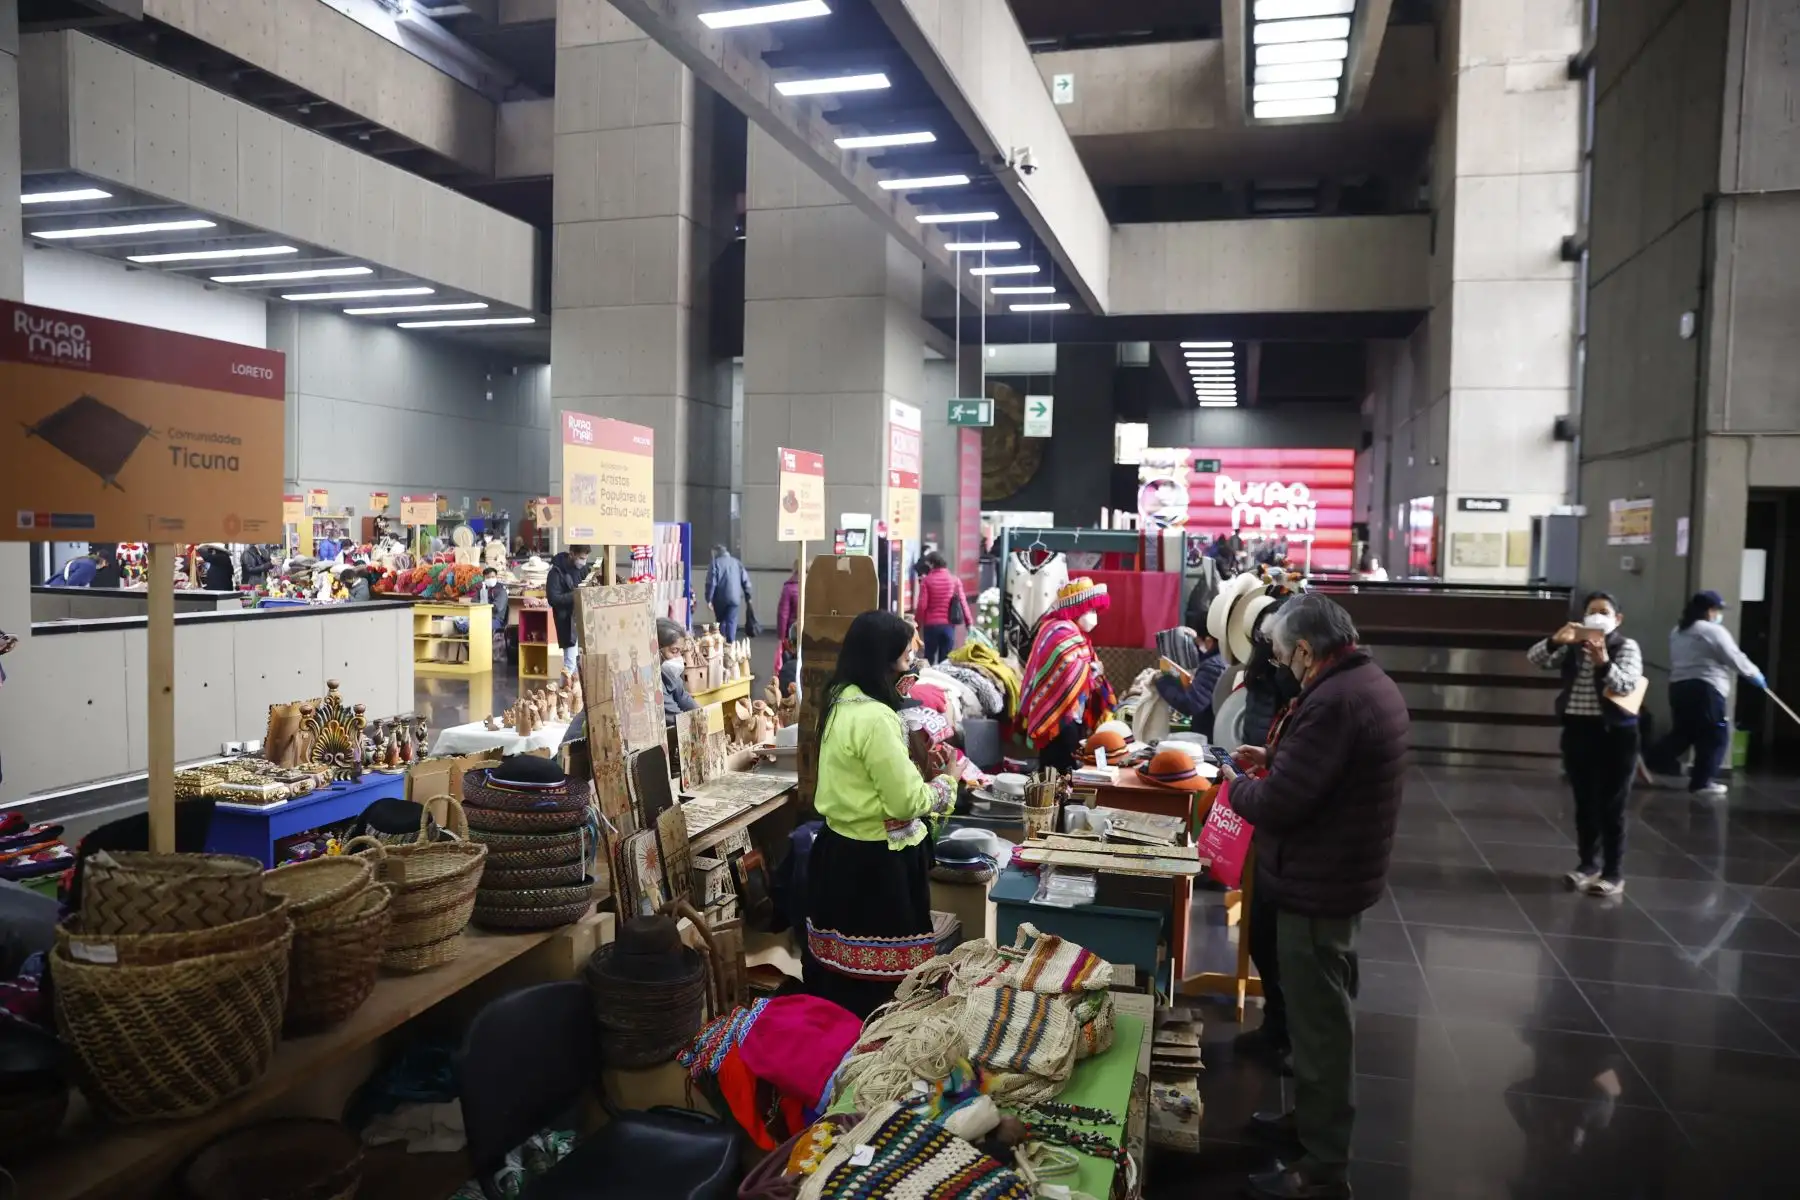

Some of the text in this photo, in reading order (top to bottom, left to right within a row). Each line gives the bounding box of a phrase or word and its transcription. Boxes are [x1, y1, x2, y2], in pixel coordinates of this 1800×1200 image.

[231, 362, 274, 381] LORETO
[167, 426, 242, 446] Comunidades
[168, 445, 240, 472] Ticuna
